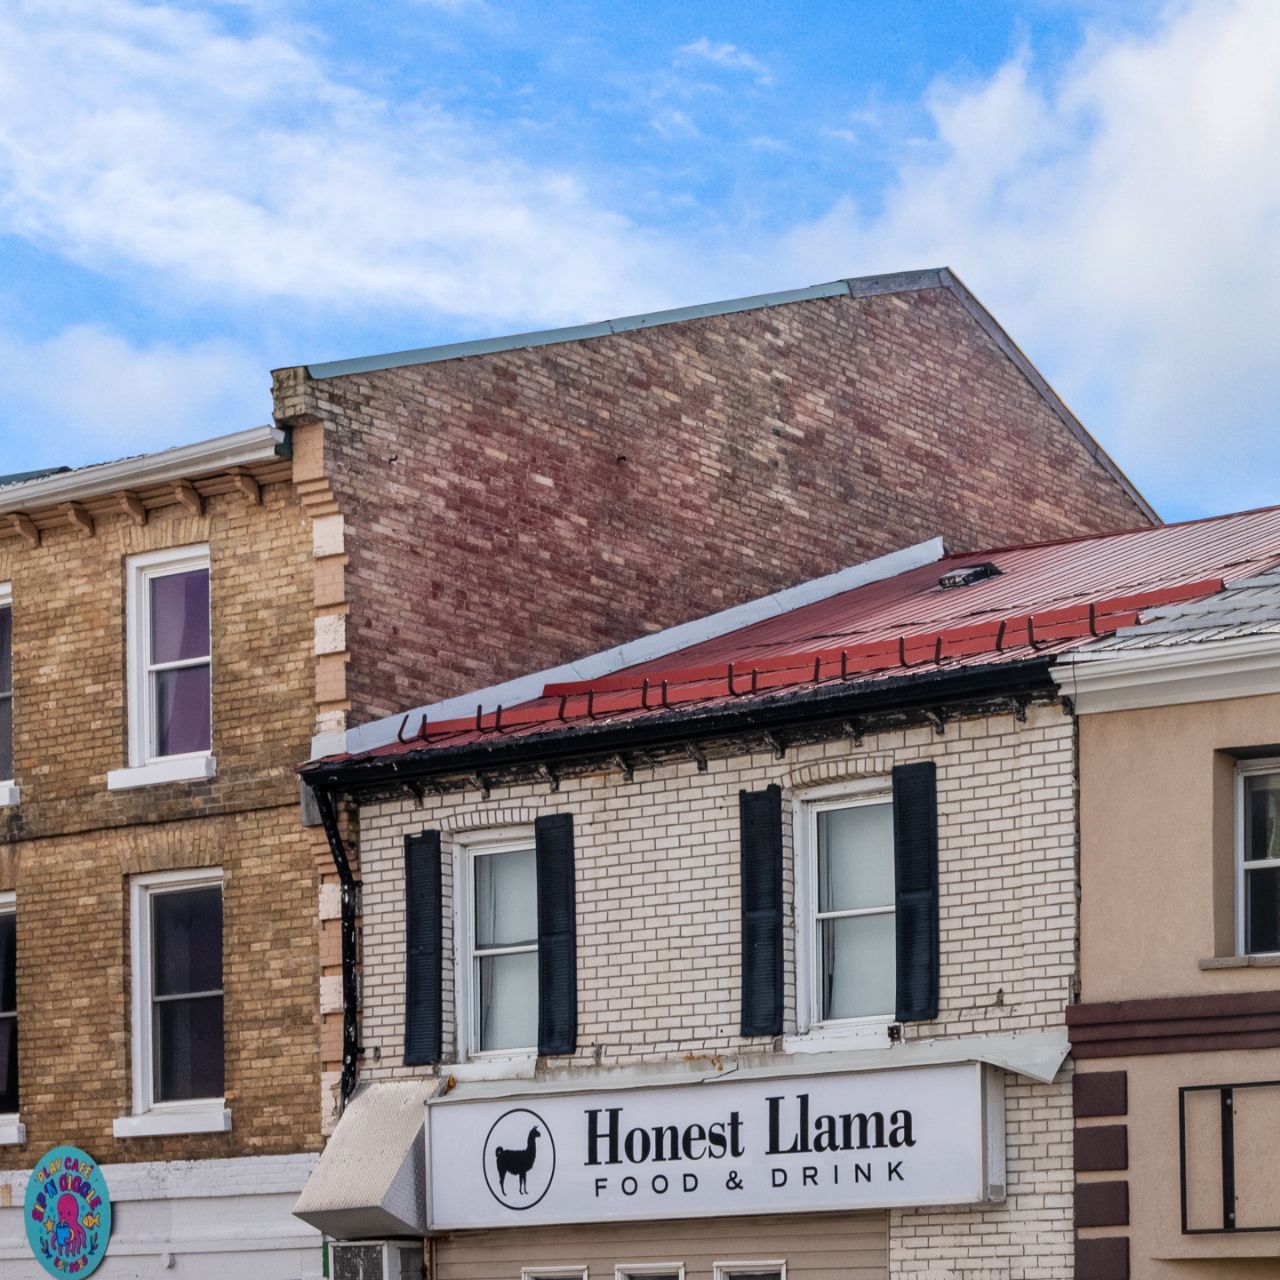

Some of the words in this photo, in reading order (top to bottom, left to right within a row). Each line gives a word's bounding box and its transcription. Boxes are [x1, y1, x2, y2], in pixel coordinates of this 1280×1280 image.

[584, 1107, 745, 1165] Honest
[765, 1093, 916, 1155] Llama
[37, 1157, 62, 1184] PLAY
[595, 1173, 698, 1197] FOOD
[726, 1170, 743, 1190] &
[772, 1161, 904, 1188] DRINK
[32, 1192, 47, 1222] SIP
